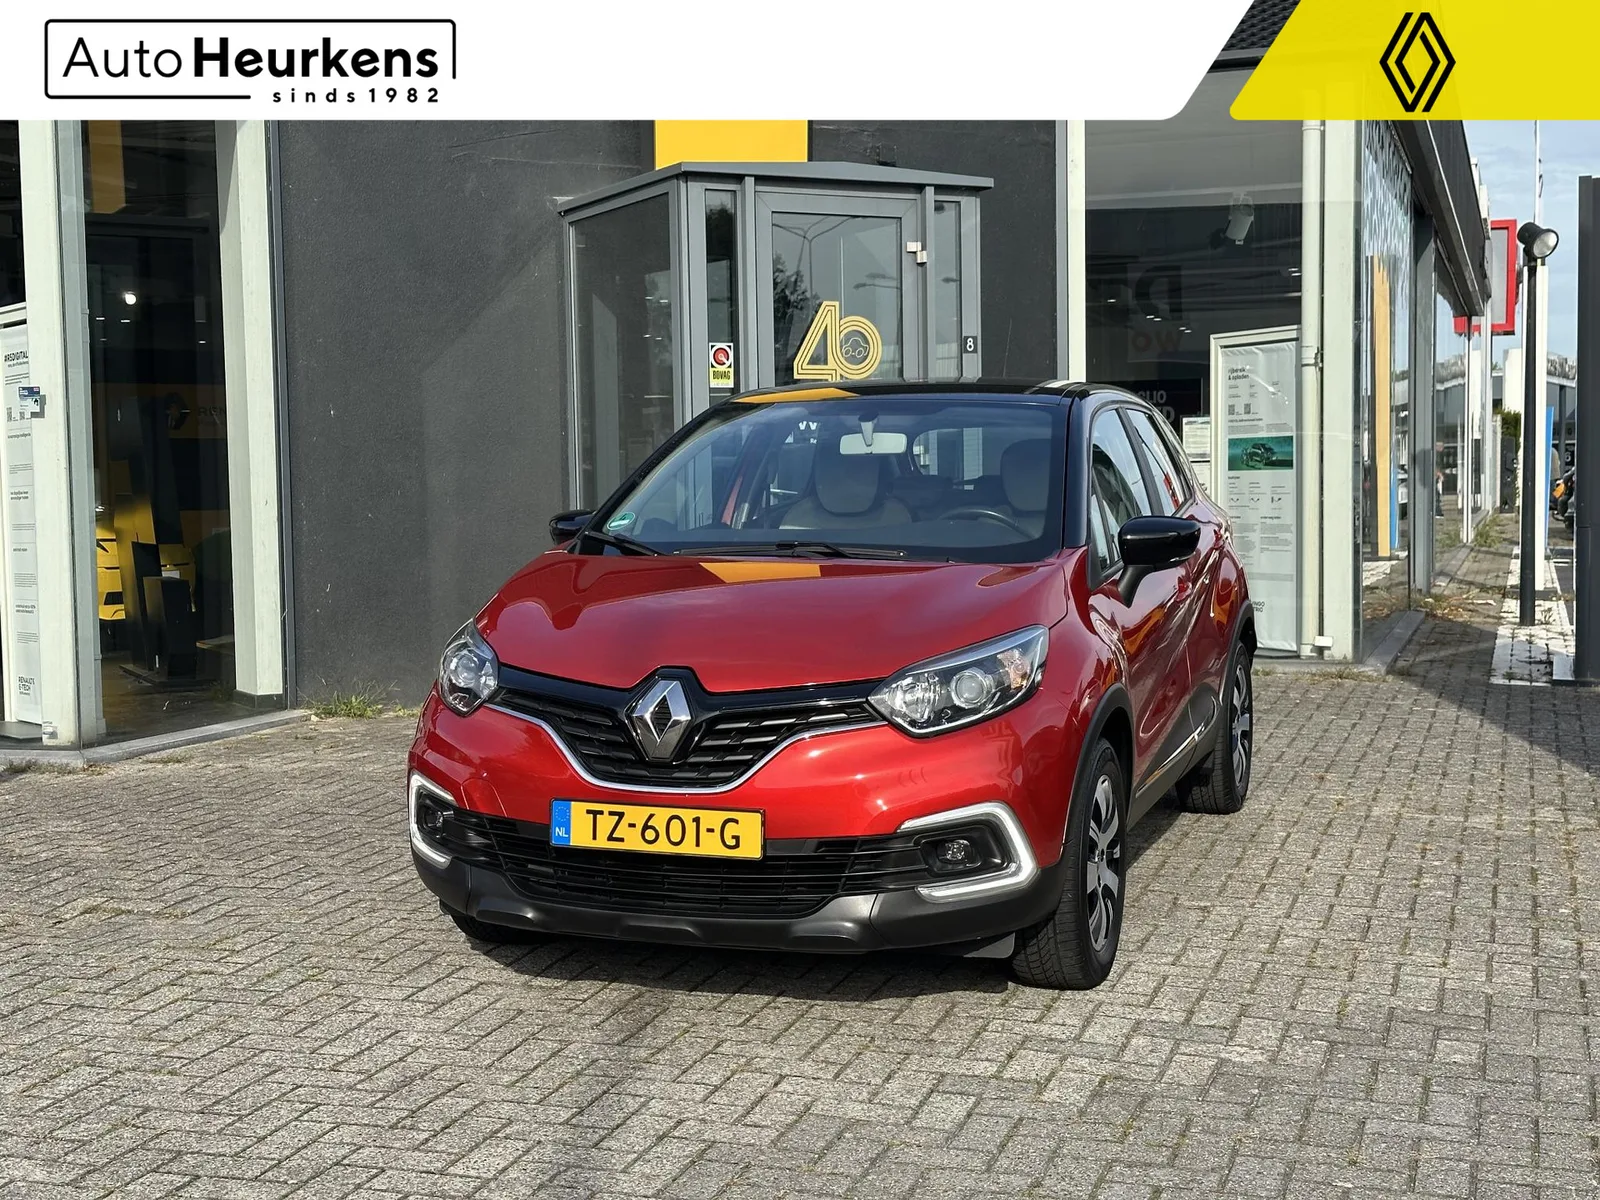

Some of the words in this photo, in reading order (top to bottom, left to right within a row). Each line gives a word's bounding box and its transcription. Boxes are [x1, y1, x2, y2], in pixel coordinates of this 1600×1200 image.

[794, 301, 882, 382] 40
[966, 337, 975, 351] 8
[712, 370, 730, 380] BOVAG
[555, 827, 569, 838] NL
[586, 809, 741, 850] TZ-601-G
